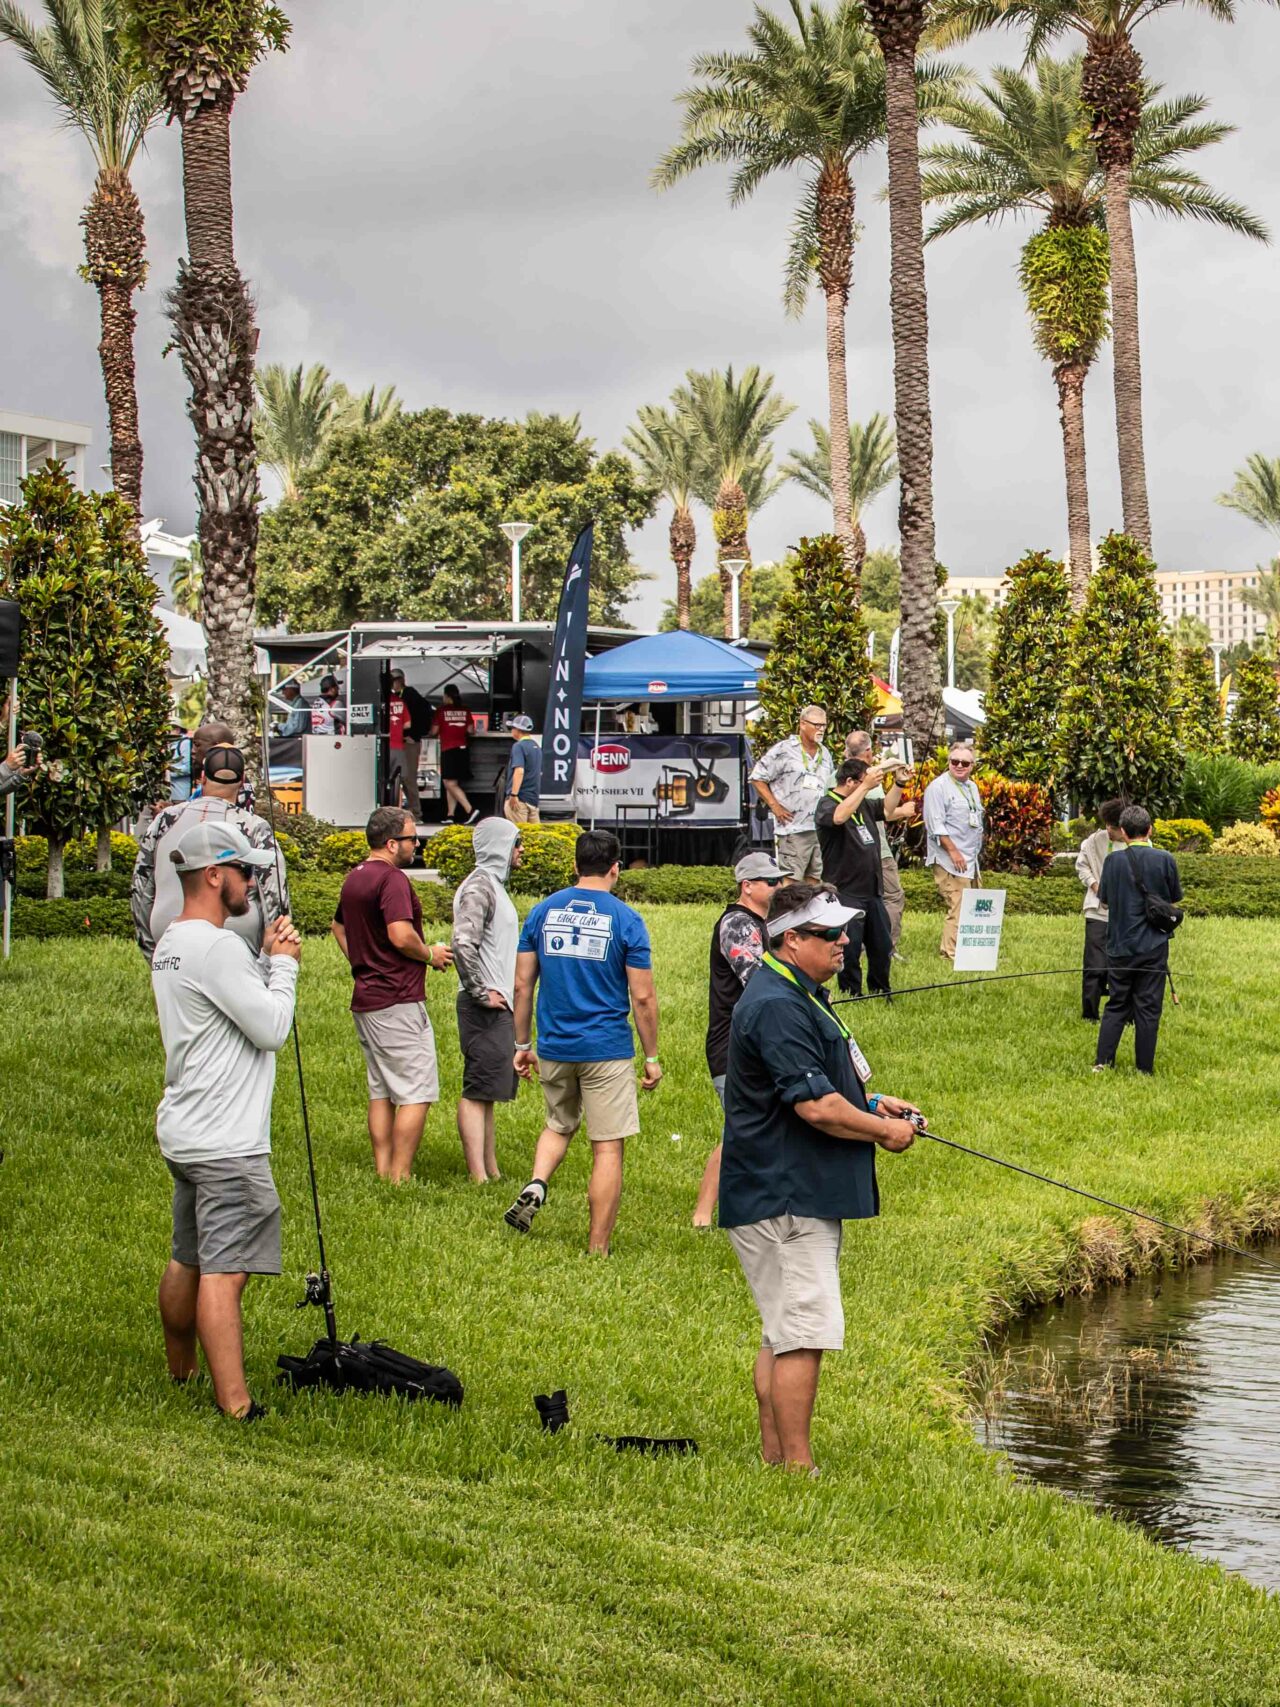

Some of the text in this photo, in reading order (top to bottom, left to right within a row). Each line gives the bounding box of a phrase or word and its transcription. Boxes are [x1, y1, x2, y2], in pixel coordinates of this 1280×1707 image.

[593, 752, 628, 766] PENN
[630, 787, 643, 796] VII
[556, 913, 600, 926] EAGLE CLAW
[169, 956, 181, 970] FC
